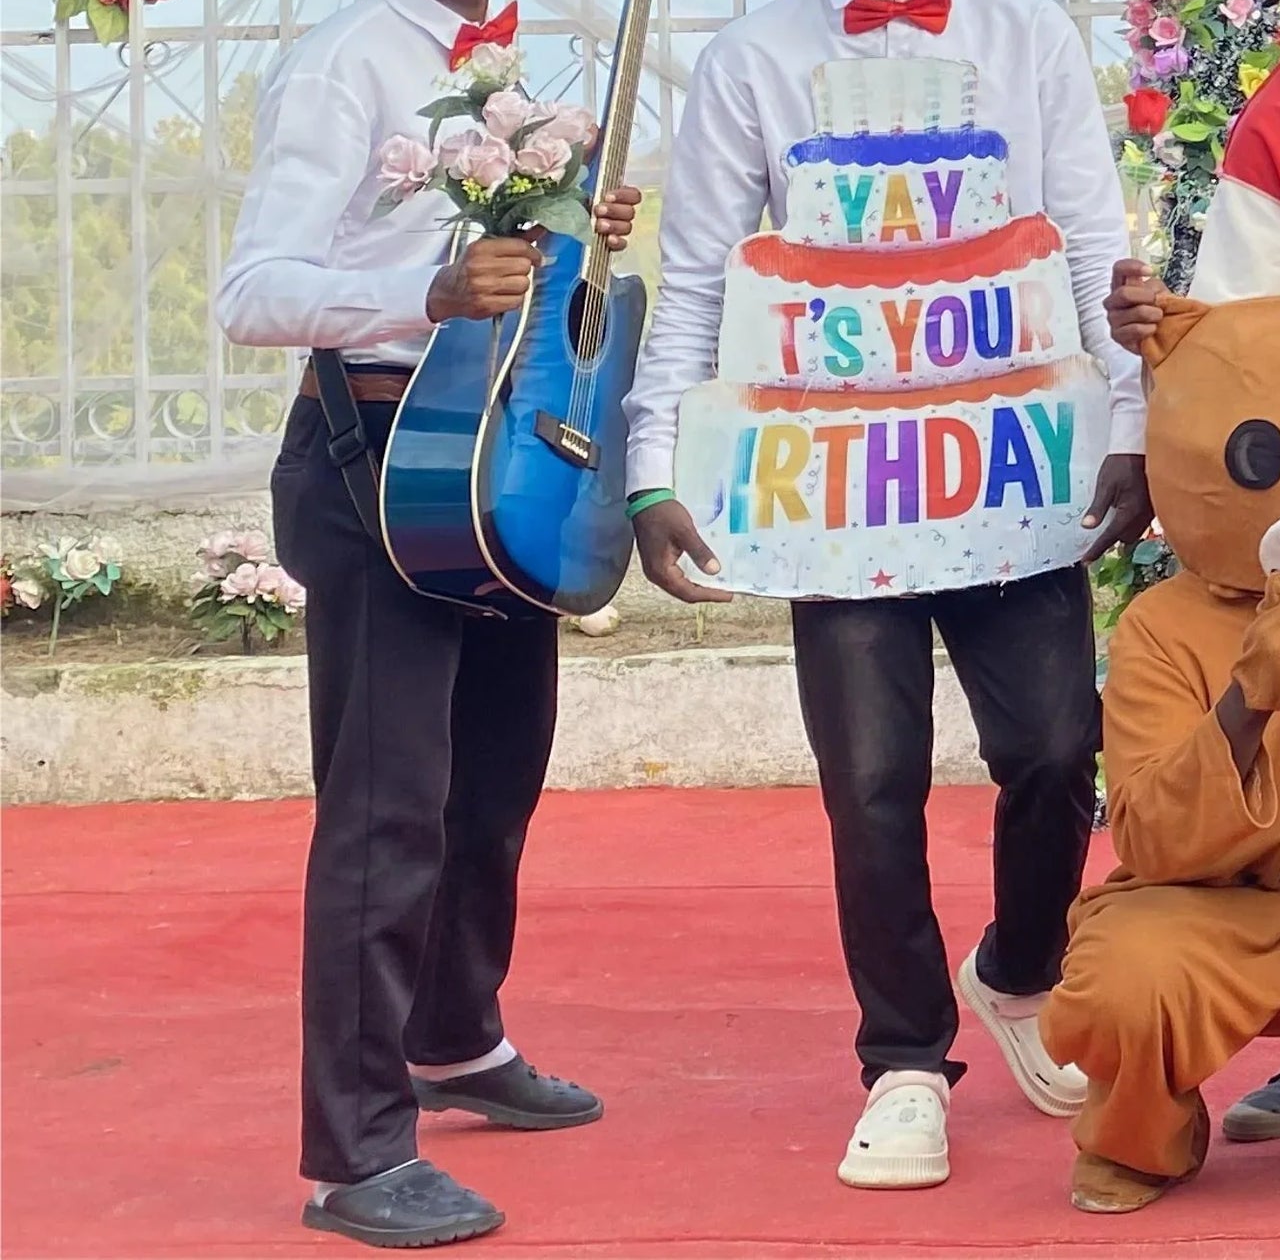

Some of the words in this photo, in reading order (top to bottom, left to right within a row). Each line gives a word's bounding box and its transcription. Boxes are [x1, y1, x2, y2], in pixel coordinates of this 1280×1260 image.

[833, 169, 965, 244] YAY
[879, 280, 1055, 374] YOUR
[703, 400, 1076, 535] IRTHDAY
